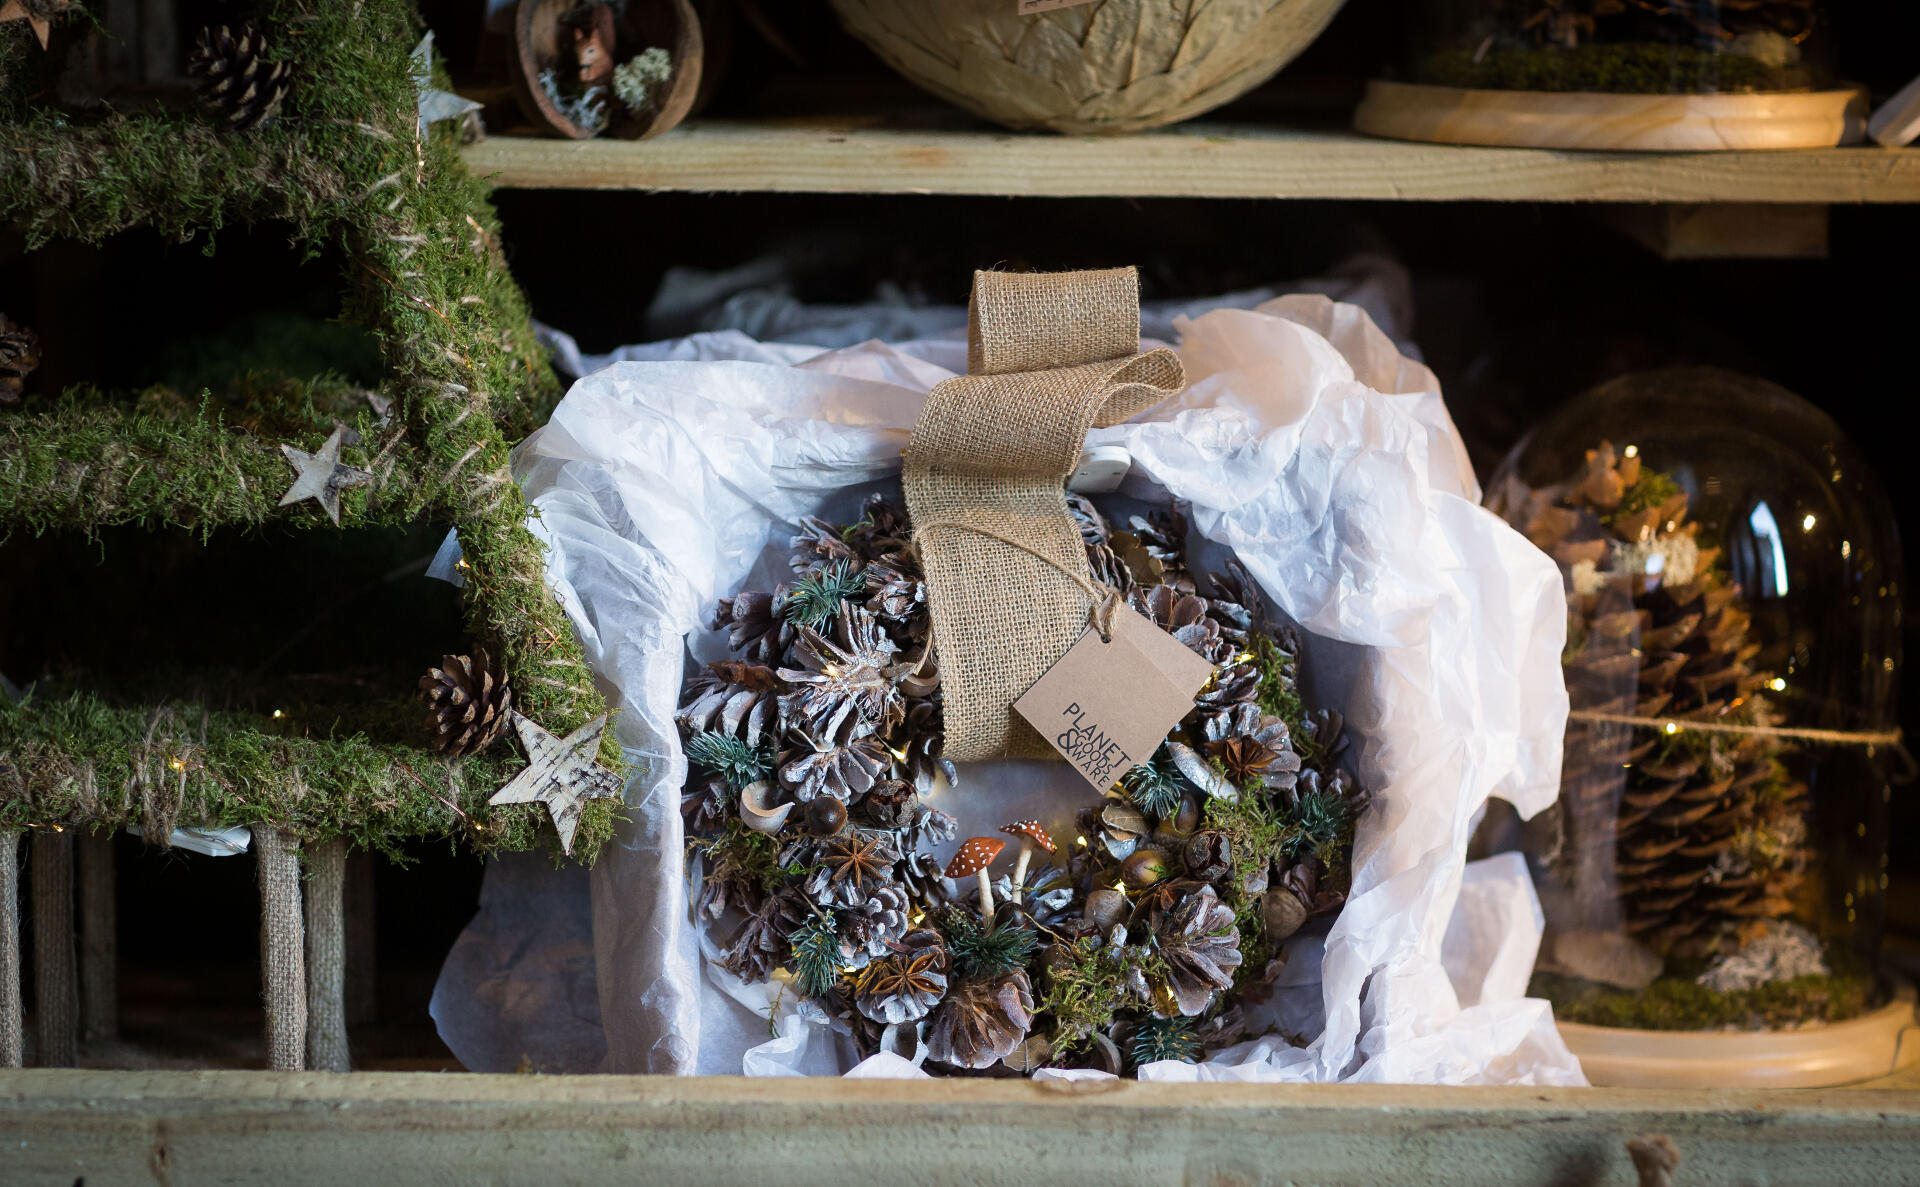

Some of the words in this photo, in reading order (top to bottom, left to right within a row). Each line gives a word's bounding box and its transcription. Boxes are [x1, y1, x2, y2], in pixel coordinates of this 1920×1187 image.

[1057, 728, 1079, 754] &
[1062, 702, 1131, 768] PLANET
[1075, 735, 1114, 775] GOODS
[1072, 747, 1110, 787] WARE
